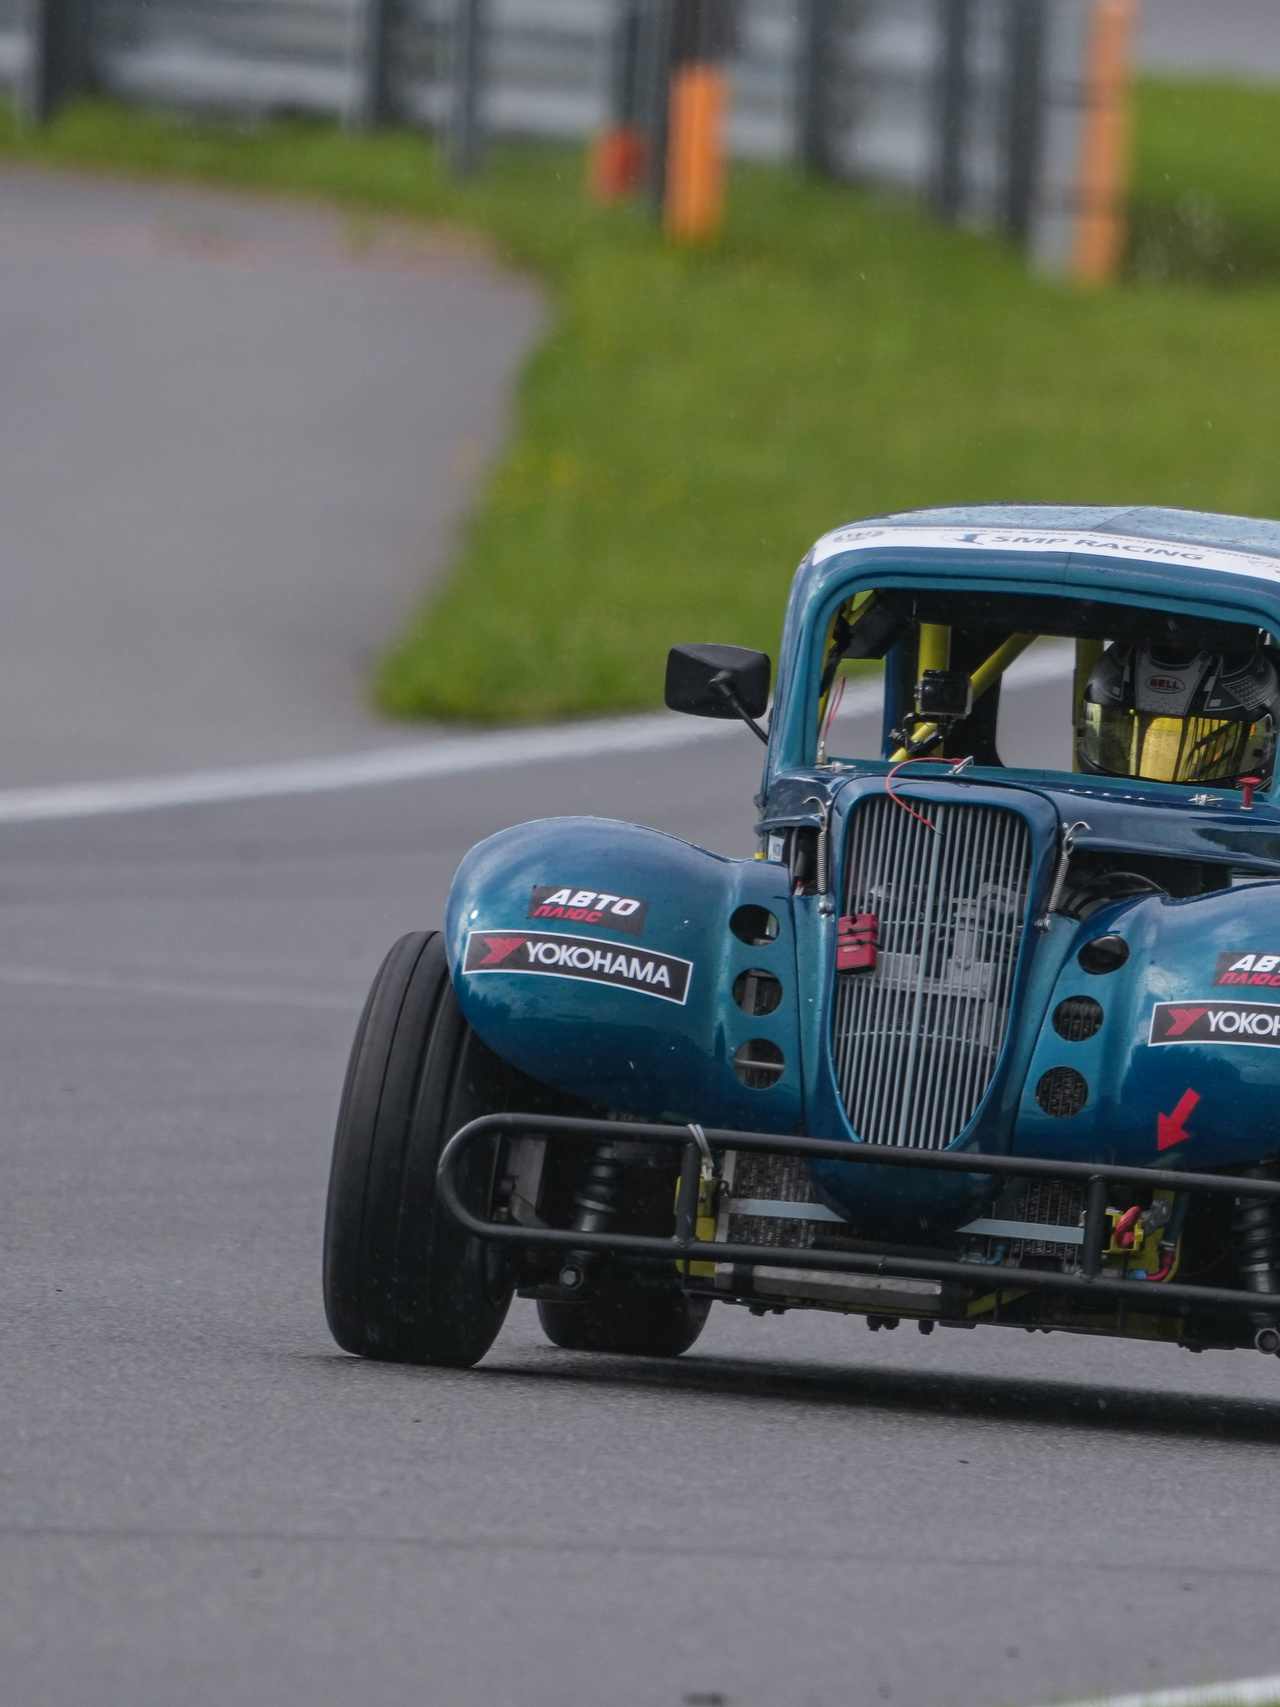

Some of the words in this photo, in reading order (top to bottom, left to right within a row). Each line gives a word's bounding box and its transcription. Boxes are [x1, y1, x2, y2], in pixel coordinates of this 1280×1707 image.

[990, 535, 1069, 545] SMP
[1074, 538, 1204, 561] RACING
[1150, 679, 1181, 690] BELL
[533, 905, 603, 923] ПЛЮС
[542, 888, 641, 916] АВТО
[526, 941, 671, 988] YOKOHAMA
